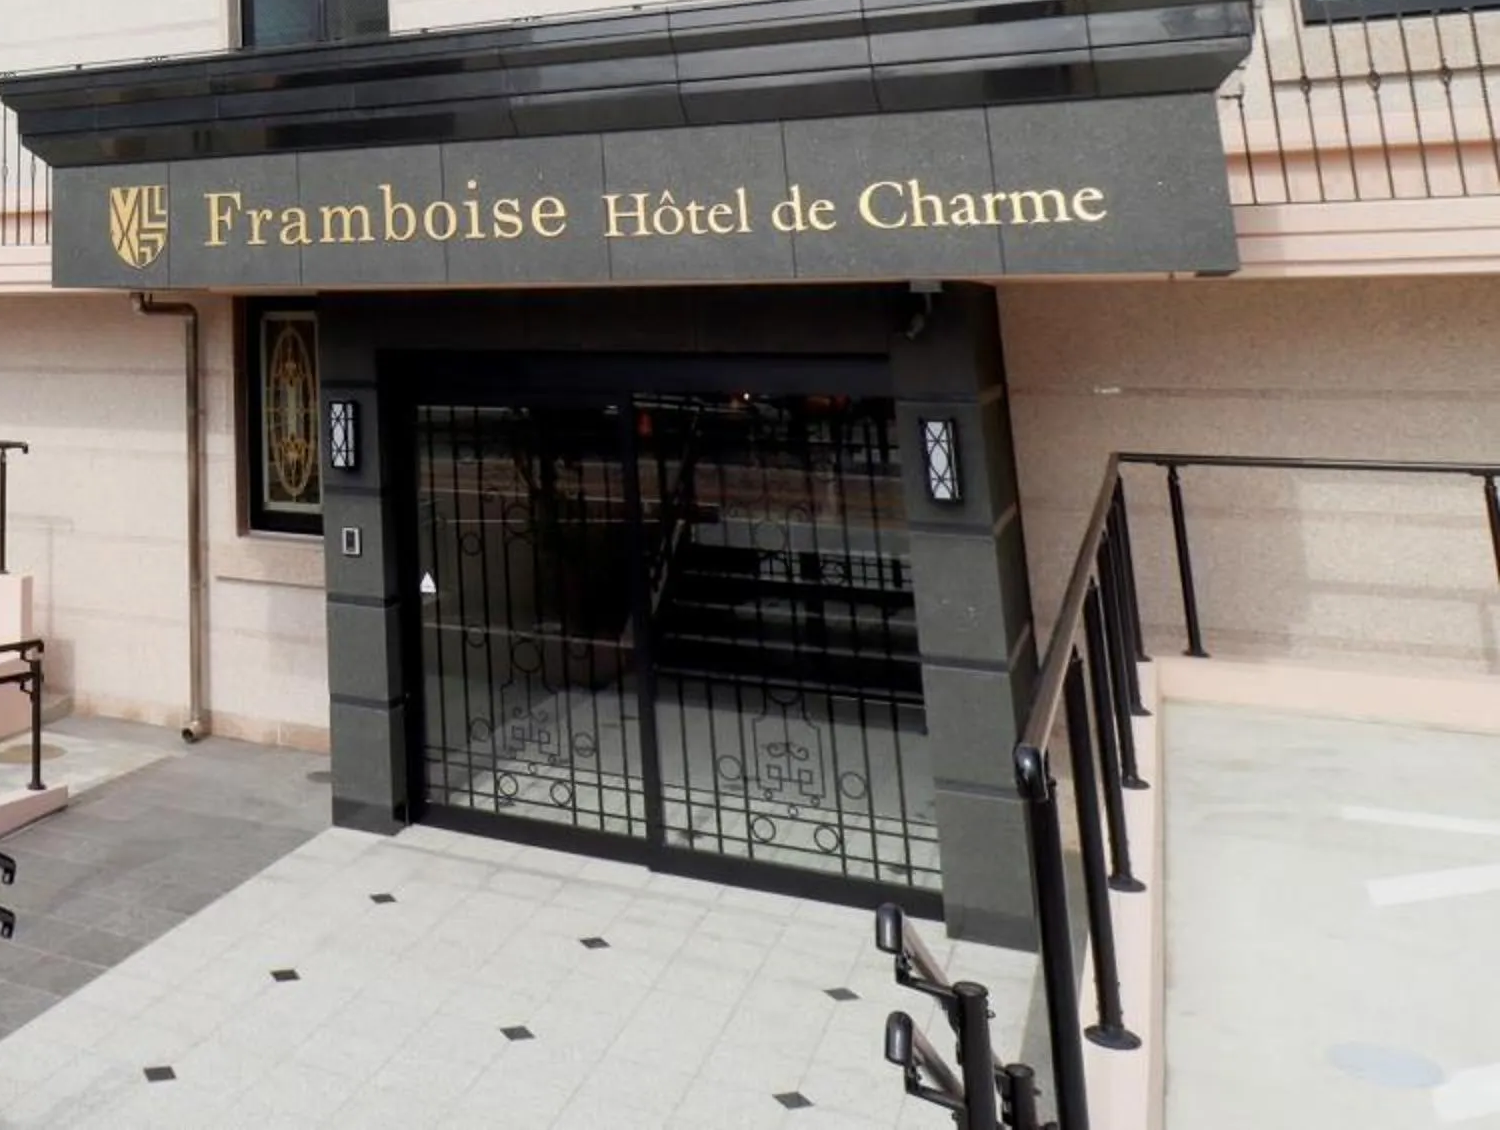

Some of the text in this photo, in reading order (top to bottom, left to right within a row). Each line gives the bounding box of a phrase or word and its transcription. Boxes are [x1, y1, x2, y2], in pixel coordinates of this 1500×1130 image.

[204, 178, 1109, 247] Framboise Hôtel de Charme
